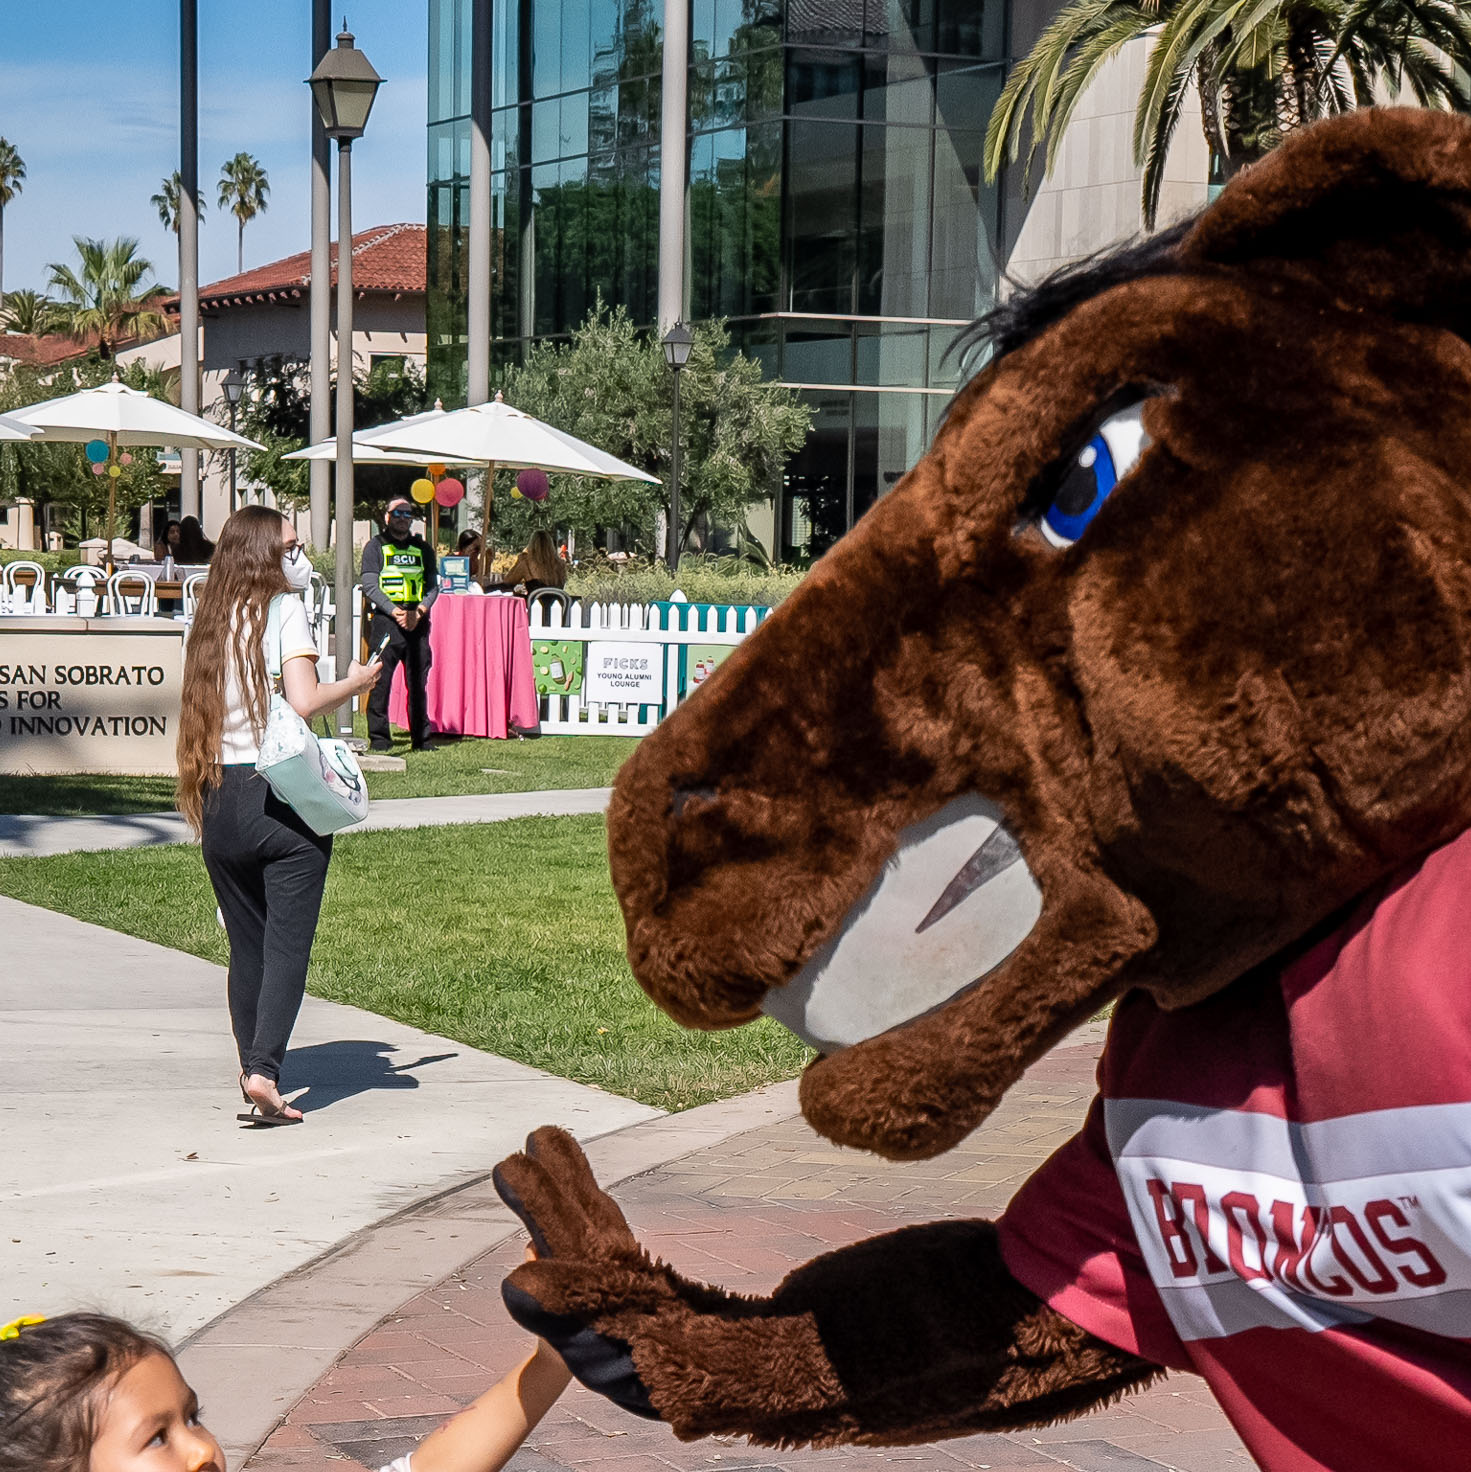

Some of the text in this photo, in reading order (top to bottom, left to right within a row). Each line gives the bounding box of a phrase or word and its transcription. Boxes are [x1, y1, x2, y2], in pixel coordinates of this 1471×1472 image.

[393, 555, 416, 564] SCU
[603, 657, 648, 670] FICKS
[54, 666, 165, 685] SOBRATO
[597, 672, 623, 680] YOUNG
[16, 690, 63, 710] FOR
[10, 716, 167, 736] INNOVATION
